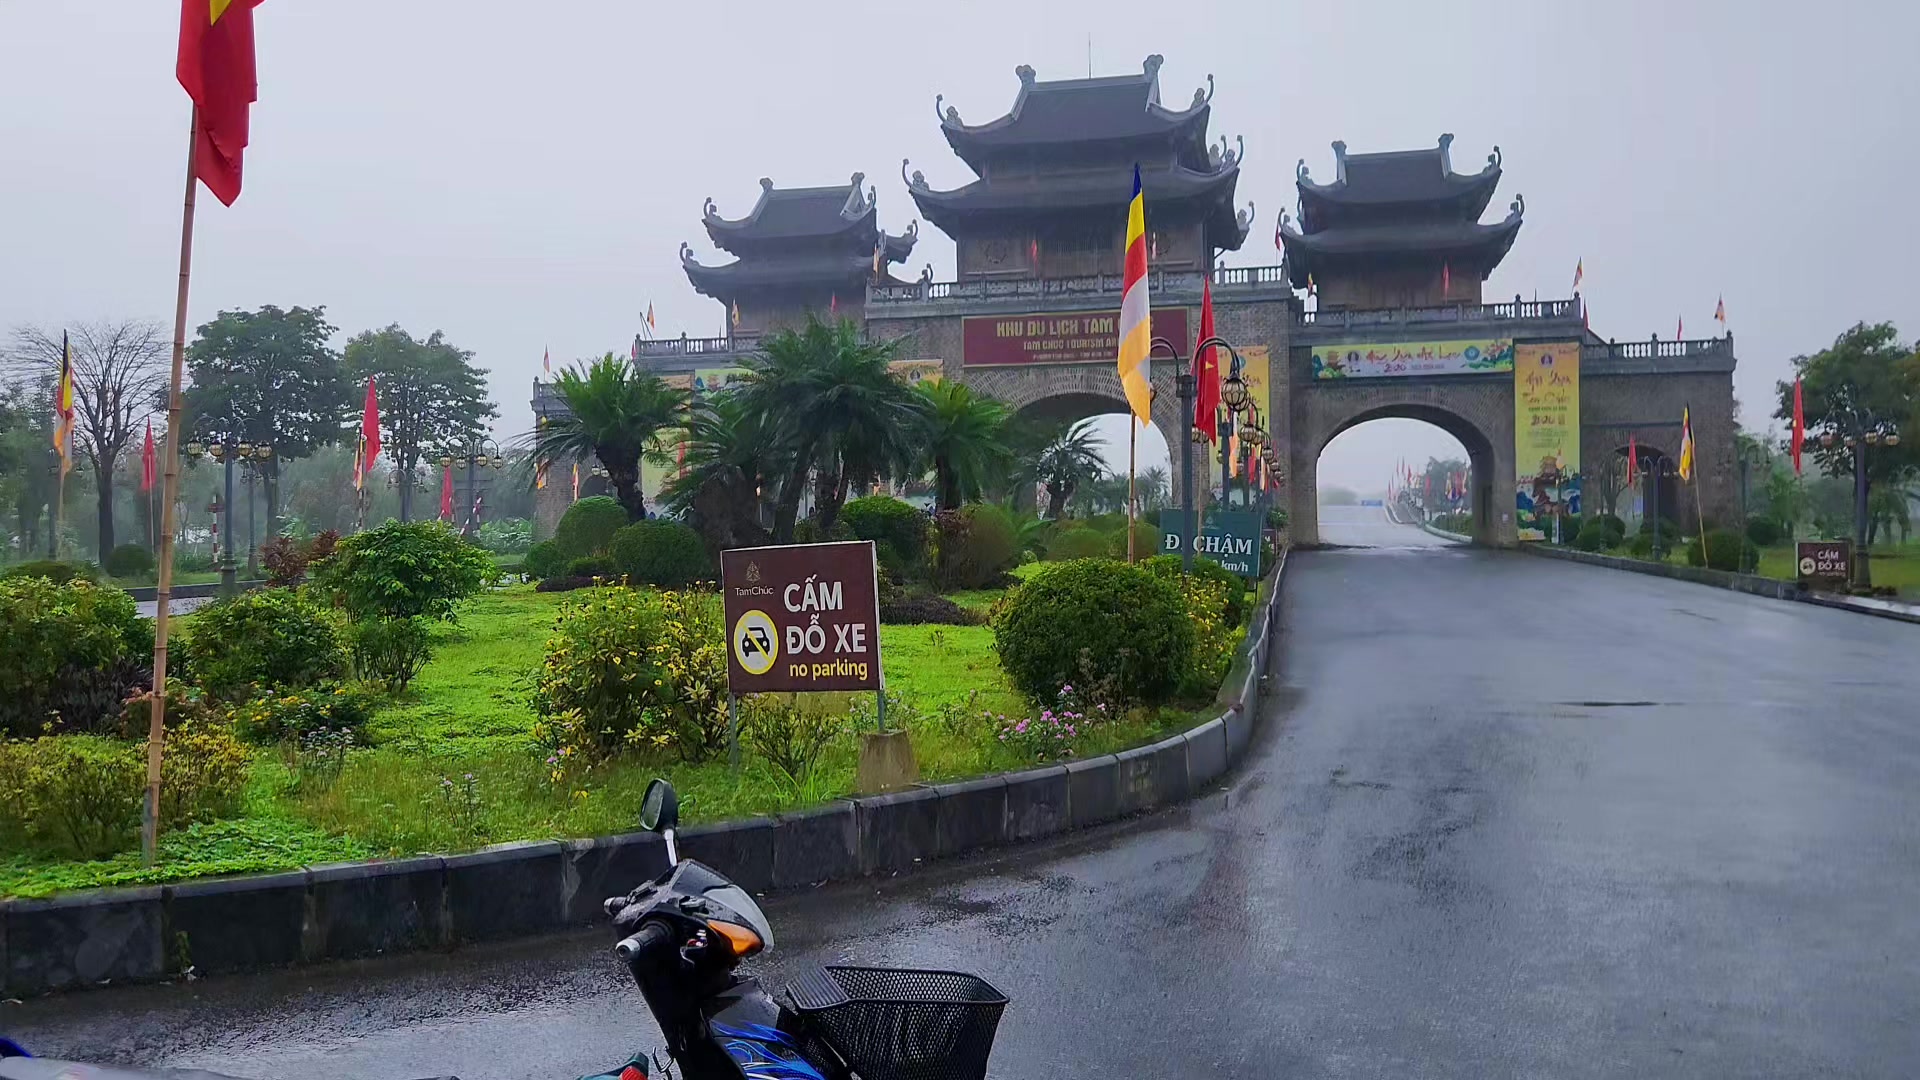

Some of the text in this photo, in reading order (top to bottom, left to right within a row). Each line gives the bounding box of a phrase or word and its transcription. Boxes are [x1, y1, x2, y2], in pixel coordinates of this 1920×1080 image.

[996, 321, 1023, 337] KHU
[1027, 320, 1046, 337] DU
[1049, 319, 1079, 338] LỊCH
[1084, 317, 1113, 334] TAM
[1193, 533, 1253, 558] CHẬM
[1221, 559, 1249, 572] km/h
[784, 574, 843, 613] CẤM
[786, 613, 867, 655] ĐỖ XE
[789, 658, 868, 681] no parking
